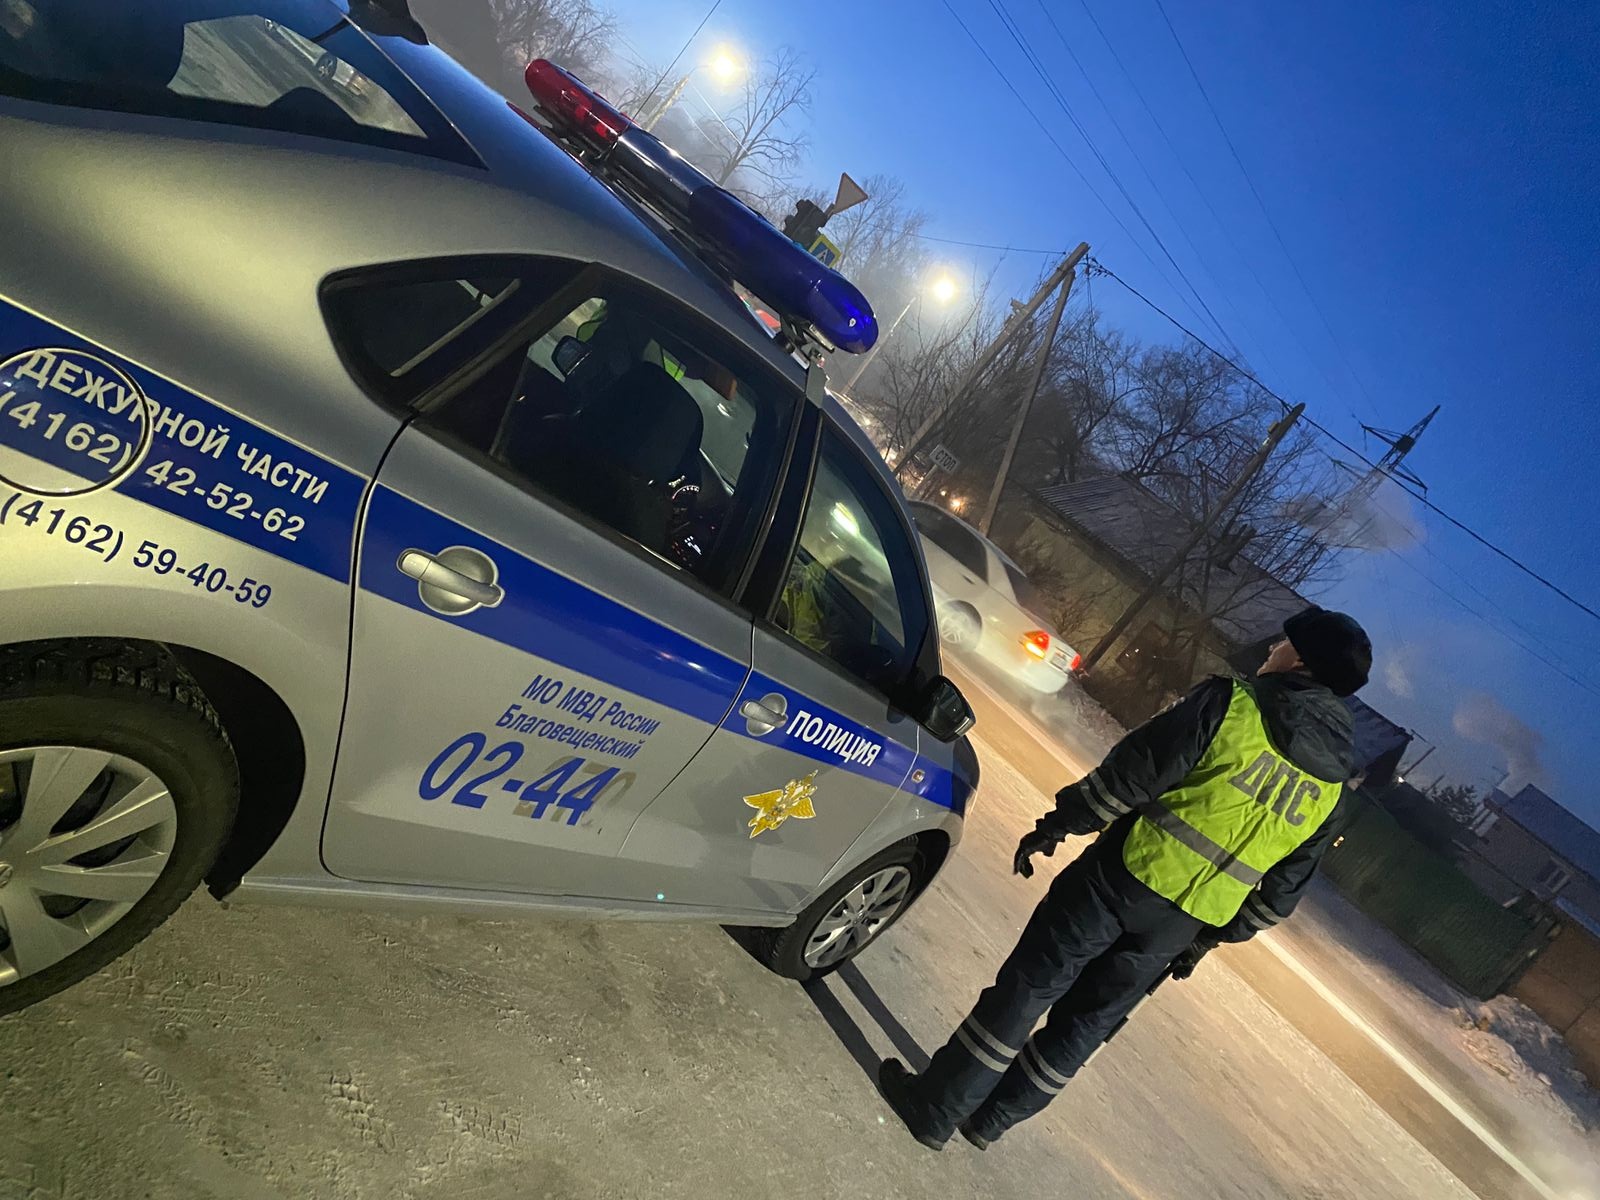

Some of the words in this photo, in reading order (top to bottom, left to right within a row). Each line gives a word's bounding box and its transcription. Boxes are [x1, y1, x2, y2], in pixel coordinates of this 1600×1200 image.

[0, 390, 133, 474] (4162)
[145, 460, 306, 541] 42-52-62
[13, 349, 230, 459] ДЕЖУРНОЙ
[236, 442, 329, 504] ЧАСТИ
[0, 493, 124, 563] (4162)
[133, 540, 272, 608] 59-40-59
[496, 704, 646, 760] Благовещенский
[521, 674, 564, 705] МО
[556, 687, 608, 723] МВД
[599, 702, 661, 736] России
[786, 710, 882, 768] ПОЛИЦИЯ
[418, 731, 621, 826] 02-44
[1228, 750, 1322, 827] ДПС
